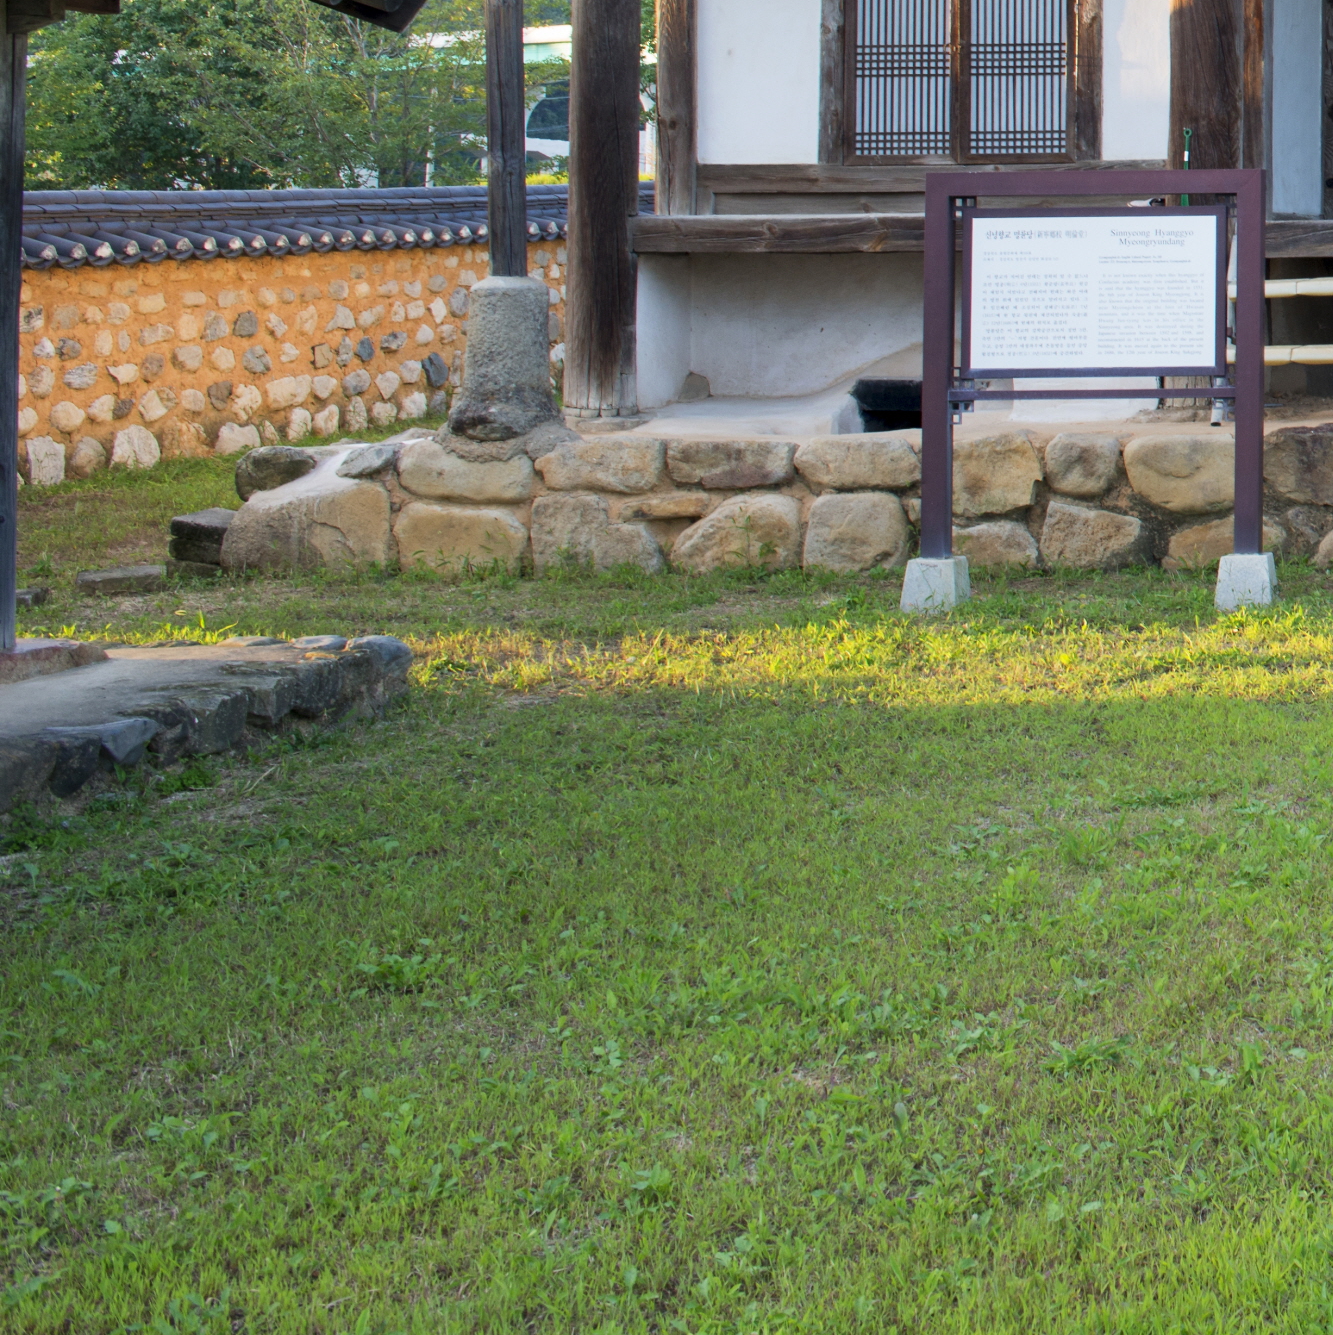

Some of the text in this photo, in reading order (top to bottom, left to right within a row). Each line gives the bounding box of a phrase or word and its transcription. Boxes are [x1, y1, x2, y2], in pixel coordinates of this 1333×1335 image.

[986, 229, 1012, 240] 신녕향교
[1110, 228, 1194, 238] Sinnyeong Hyanggyo
[1119, 237, 1186, 247] Myeongryundang
